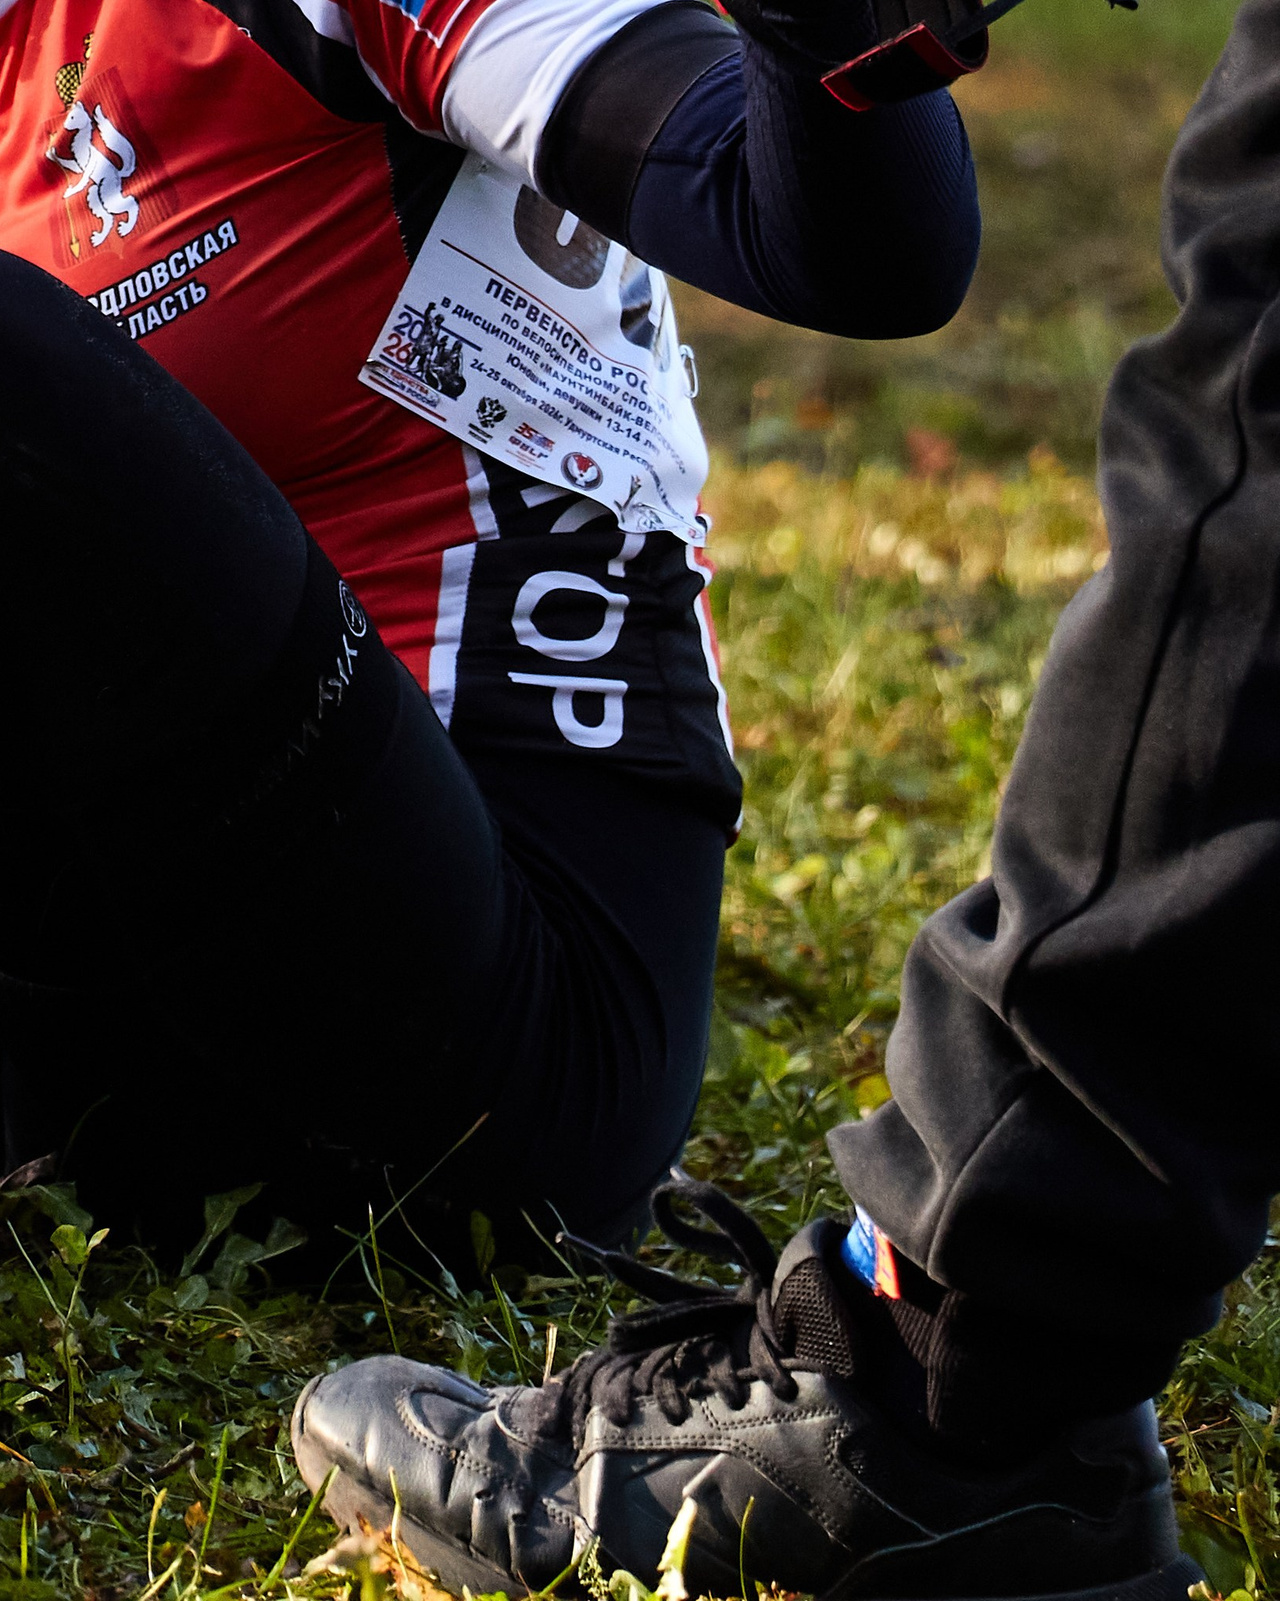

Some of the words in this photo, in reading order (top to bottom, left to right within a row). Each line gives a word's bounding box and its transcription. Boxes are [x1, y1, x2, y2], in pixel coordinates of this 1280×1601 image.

[116, 281, 207, 340] ЛАСТЬ
[440, 296, 452, 309] В
[451, 304, 541, 364] ДИСЦИПЛИНЕ
[485, 278, 602, 372] ПЕРВЕНСТВО
[470, 359, 501, 381] 24-25
[501, 313, 520, 330] ПО
[521, 326, 620, 395] ВЕЛОСИПЕДНОМУ
[506, 353, 550, 392] Юноши,
[553, 387, 603, 422] девушки
[606, 418, 641, 442] 13-14
